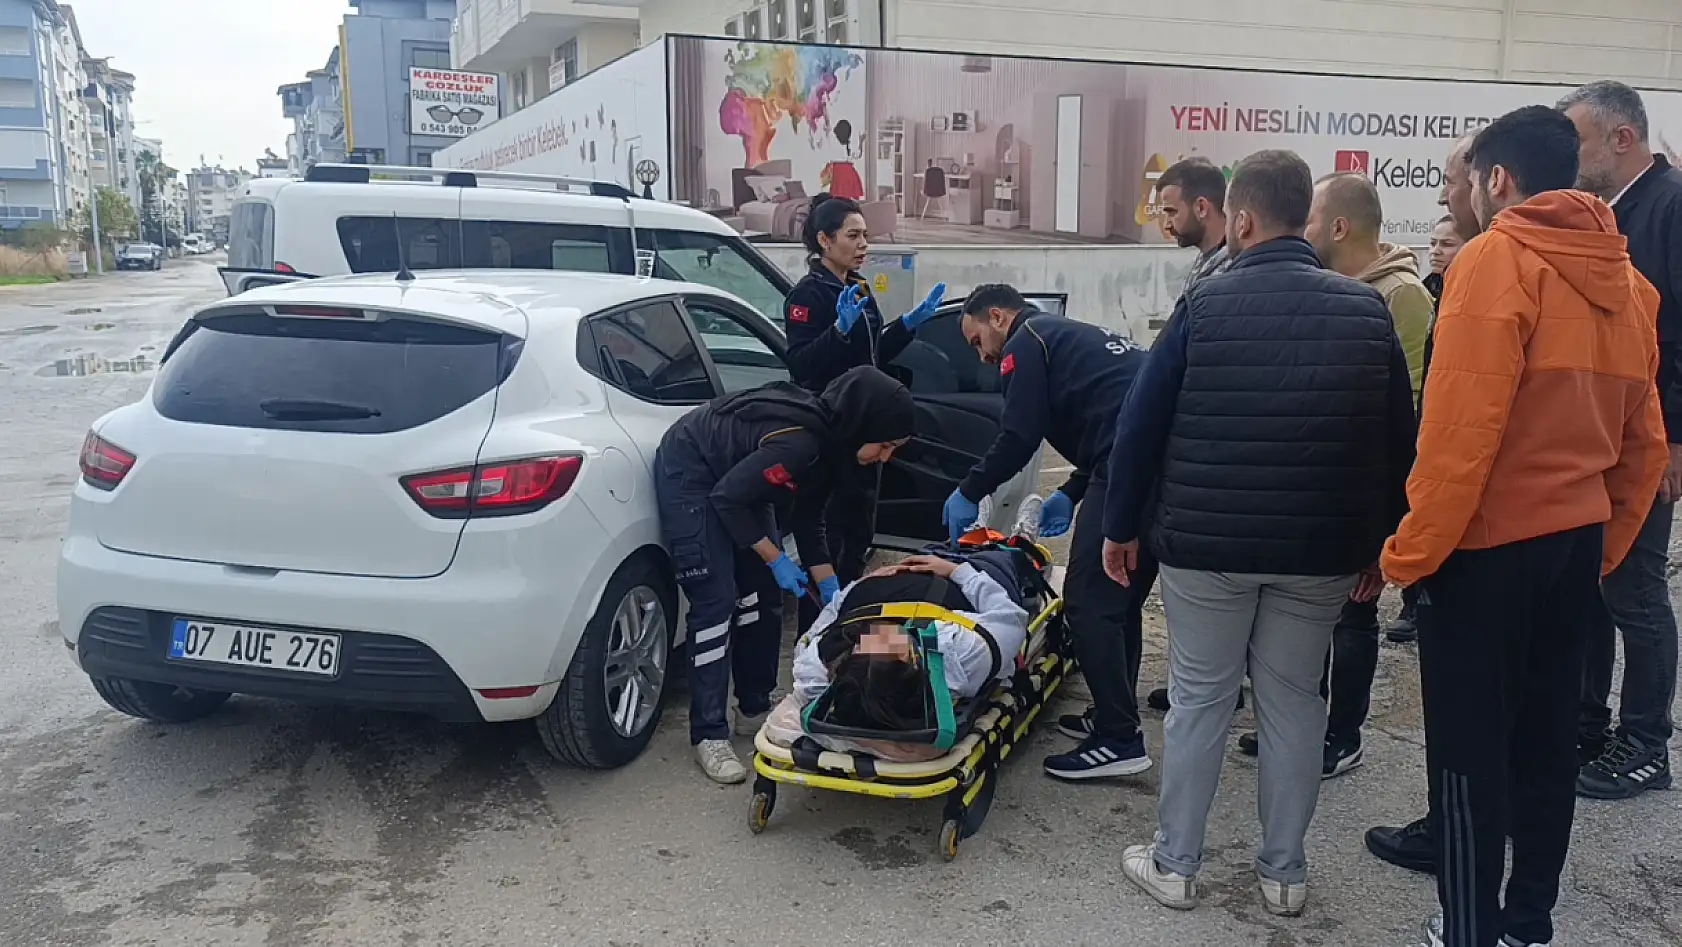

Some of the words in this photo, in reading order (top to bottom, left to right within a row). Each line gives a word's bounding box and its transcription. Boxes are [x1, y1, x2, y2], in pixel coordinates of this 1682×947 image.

[1170, 102, 1228, 132] YENİ
[1235, 104, 1320, 135] NESLİN
[1327, 111, 1418, 138] MODASI
[1423, 115, 1501, 138] KELE
[1374, 158, 1447, 188] Keleb
[185, 624, 215, 656] 07
[228, 630, 276, 664] AUE
[286, 635, 335, 670] 276
